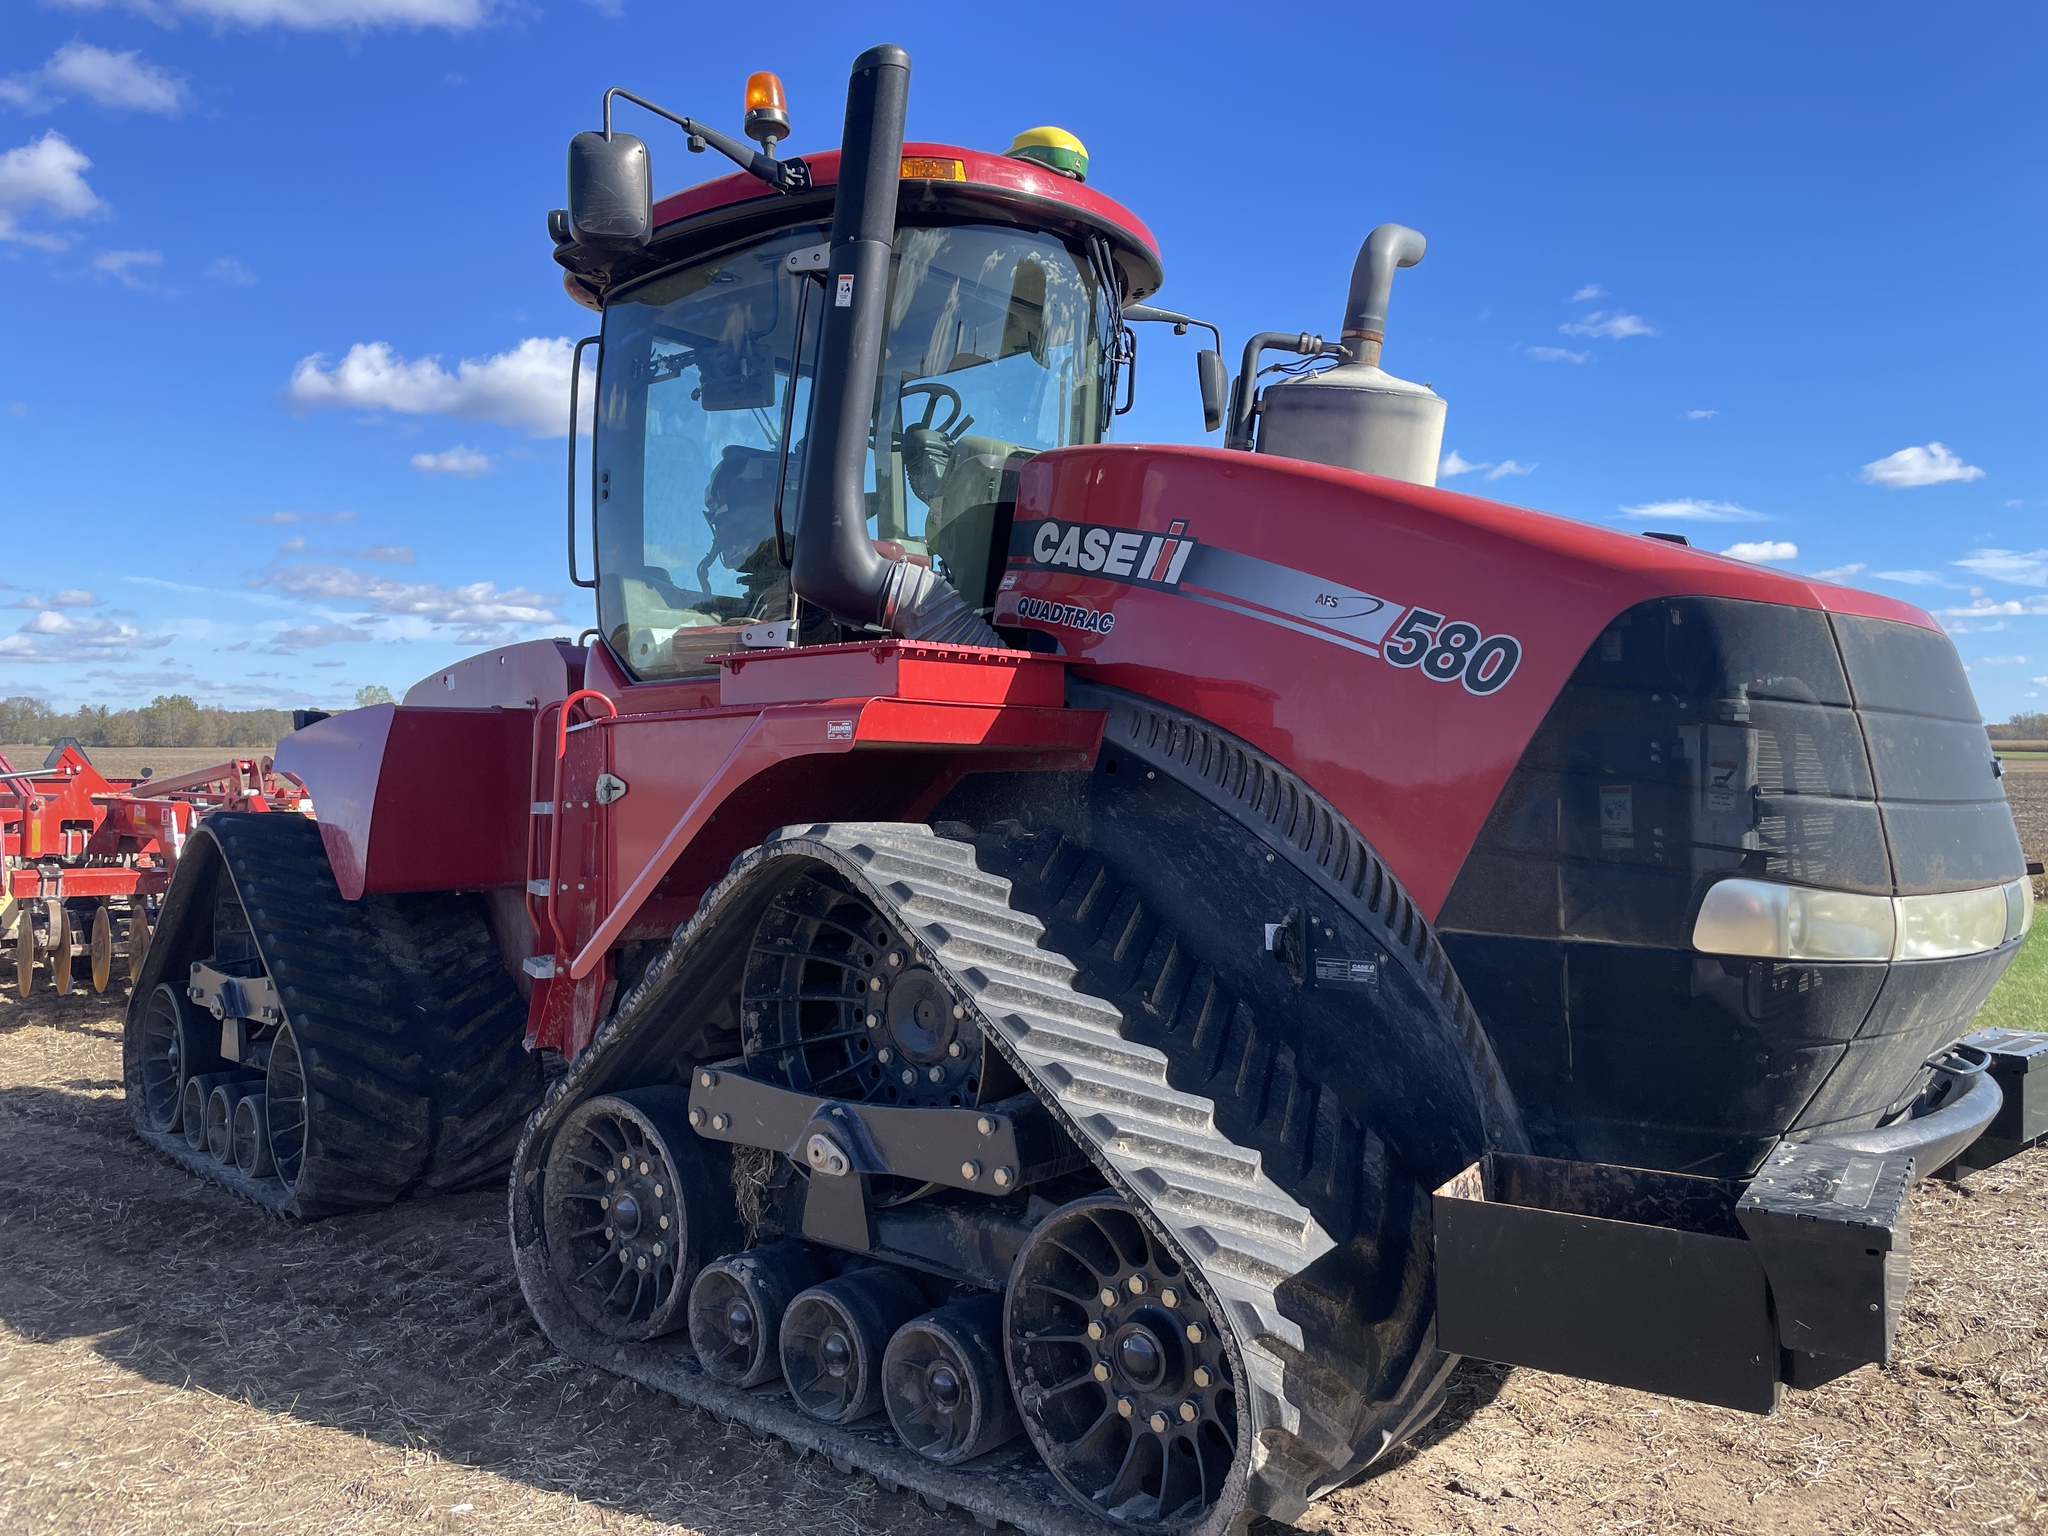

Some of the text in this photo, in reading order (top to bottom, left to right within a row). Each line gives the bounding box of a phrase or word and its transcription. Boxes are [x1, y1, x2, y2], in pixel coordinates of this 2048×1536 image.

[1033, 522, 1144, 577] CASE
[1017, 596, 1115, 635] QUADTRAC
[1315, 593, 1339, 608] AFS
[1383, 606, 1522, 696] 580
